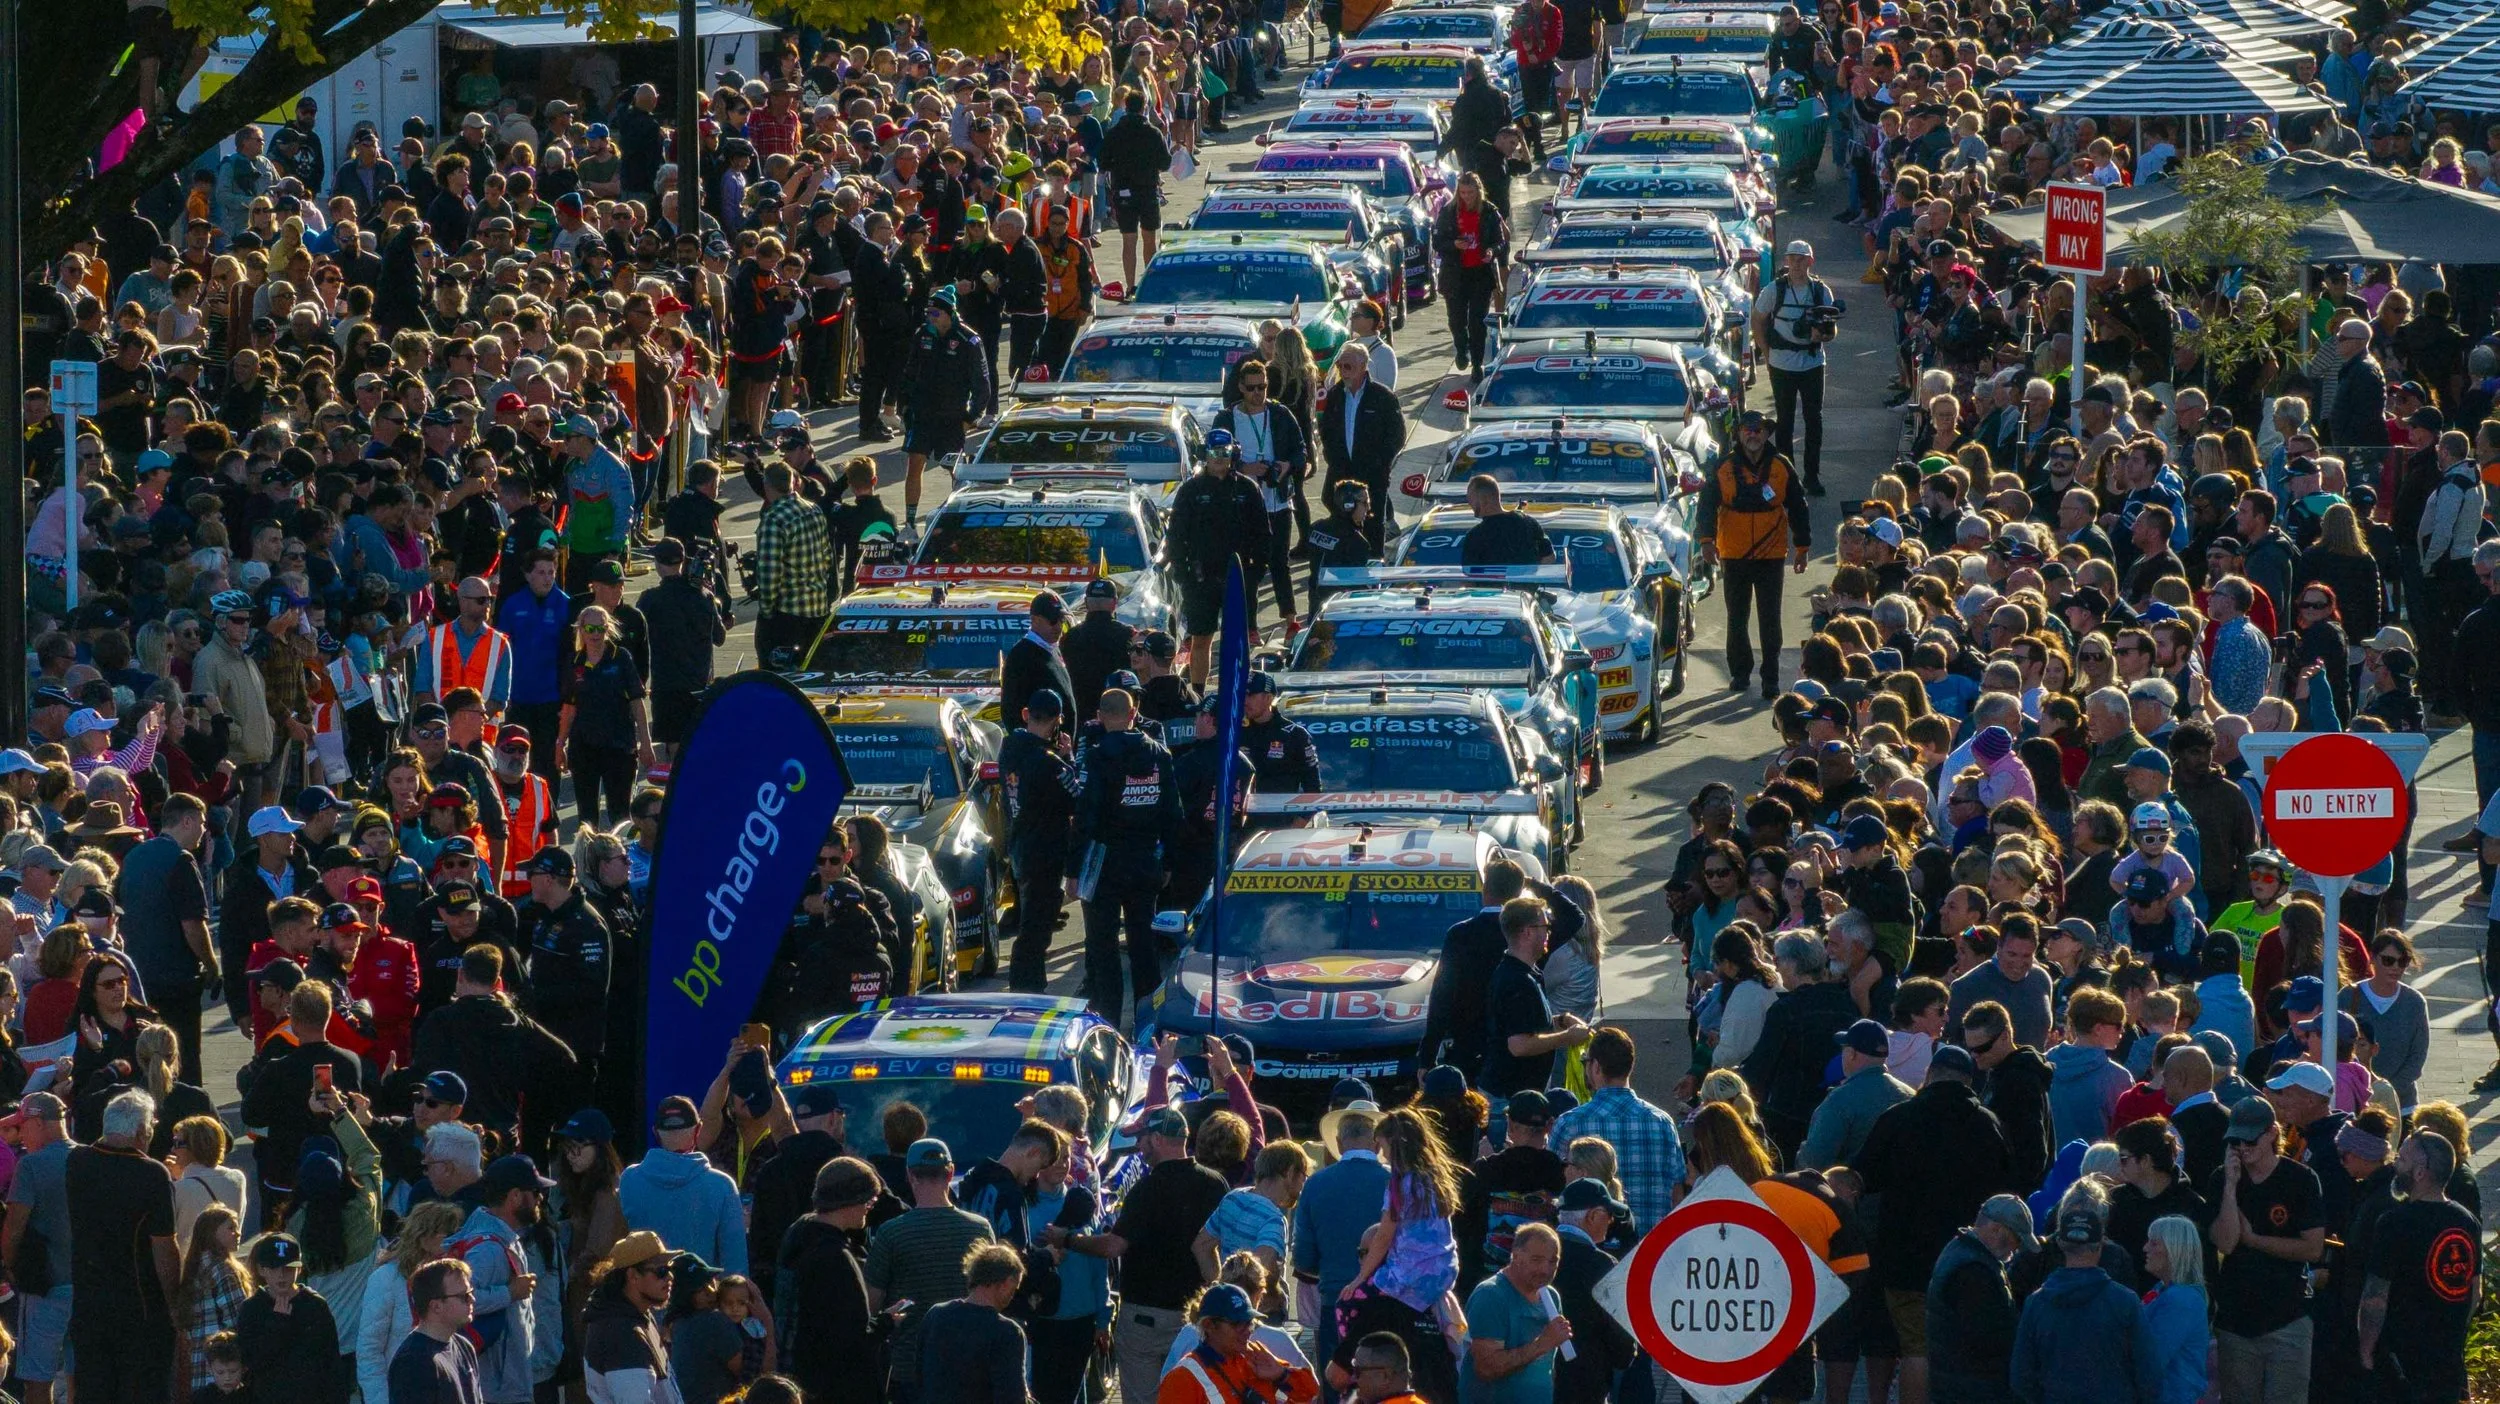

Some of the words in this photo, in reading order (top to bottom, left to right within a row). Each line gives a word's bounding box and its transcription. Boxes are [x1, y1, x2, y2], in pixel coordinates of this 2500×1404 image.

[1382, 16, 1477, 25] DAYCO
[1371, 57, 1458, 67] PIRTEK
[1622, 75, 1729, 85] DAYCO
[1307, 113, 1415, 124] Liberty
[1629, 131, 1723, 142] PIRTEK
[1596, 179, 1719, 192] Kubota
[2052, 195, 2099, 224] WRONG
[1649, 229, 1708, 237] 350
[2060, 234, 2089, 260] WAY
[1155, 253, 1247, 266] HERZOG
[1253, 253, 1312, 264] STEEL
[1218, 265, 1232, 273] 55
[1538, 288, 1687, 301] HIFLEX
[1628, 303, 1673, 311] Golding
[1111, 337, 1176, 348] TRUCK
[1178, 337, 1251, 348] ASSIST
[1573, 358, 1634, 368] EZED
[1603, 373, 1643, 382] Waters
[1000, 428, 1166, 443] erebus
[1065, 443, 1074, 452] 9
[1534, 457, 1550, 466] 25
[1571, 457, 1613, 466] Mostert
[912, 566, 1090, 577] KENWORTH
[897, 619, 1032, 631] BATTERIES
[906, 634, 926, 644] 20
[937, 634, 997, 645] Reynolds
[1437, 638, 1483, 647] Percat
[1454, 671, 1516, 682] HIRE
[1298, 717, 1440, 735] teadfast
[836, 733, 900, 743] tteries
[1350, 738, 1370, 748] 26
[1375, 737, 1453, 749] Stanaway
[1122, 786, 1161, 795] AMPOL
[1120, 795, 1160, 804] RACING
[1321, 792, 1503, 805] AMPLIFY
[2291, 794, 2312, 814] NO
[2326, 793, 2378, 813] ENTRY
[1242, 852, 1472, 868] AMPOL
[1230, 876, 1346, 890] NATIONAL
[1358, 875, 1472, 890] STORAGE
[673, 940, 723, 1008] bp
[707, 781, 786, 942] charge
[1325, 891, 1346, 902] 88
[1368, 891, 1440, 905] Feeney
[850, 981, 881, 993] NULON
[1193, 990, 1328, 1023] Red
[1331, 990, 1431, 1022] Bu
[887, 1060, 920, 1073] EV
[275, 1242, 288, 1257] T
[1686, 1257, 1760, 1290] ROAD
[1670, 1299, 1775, 1332] CLOSED
